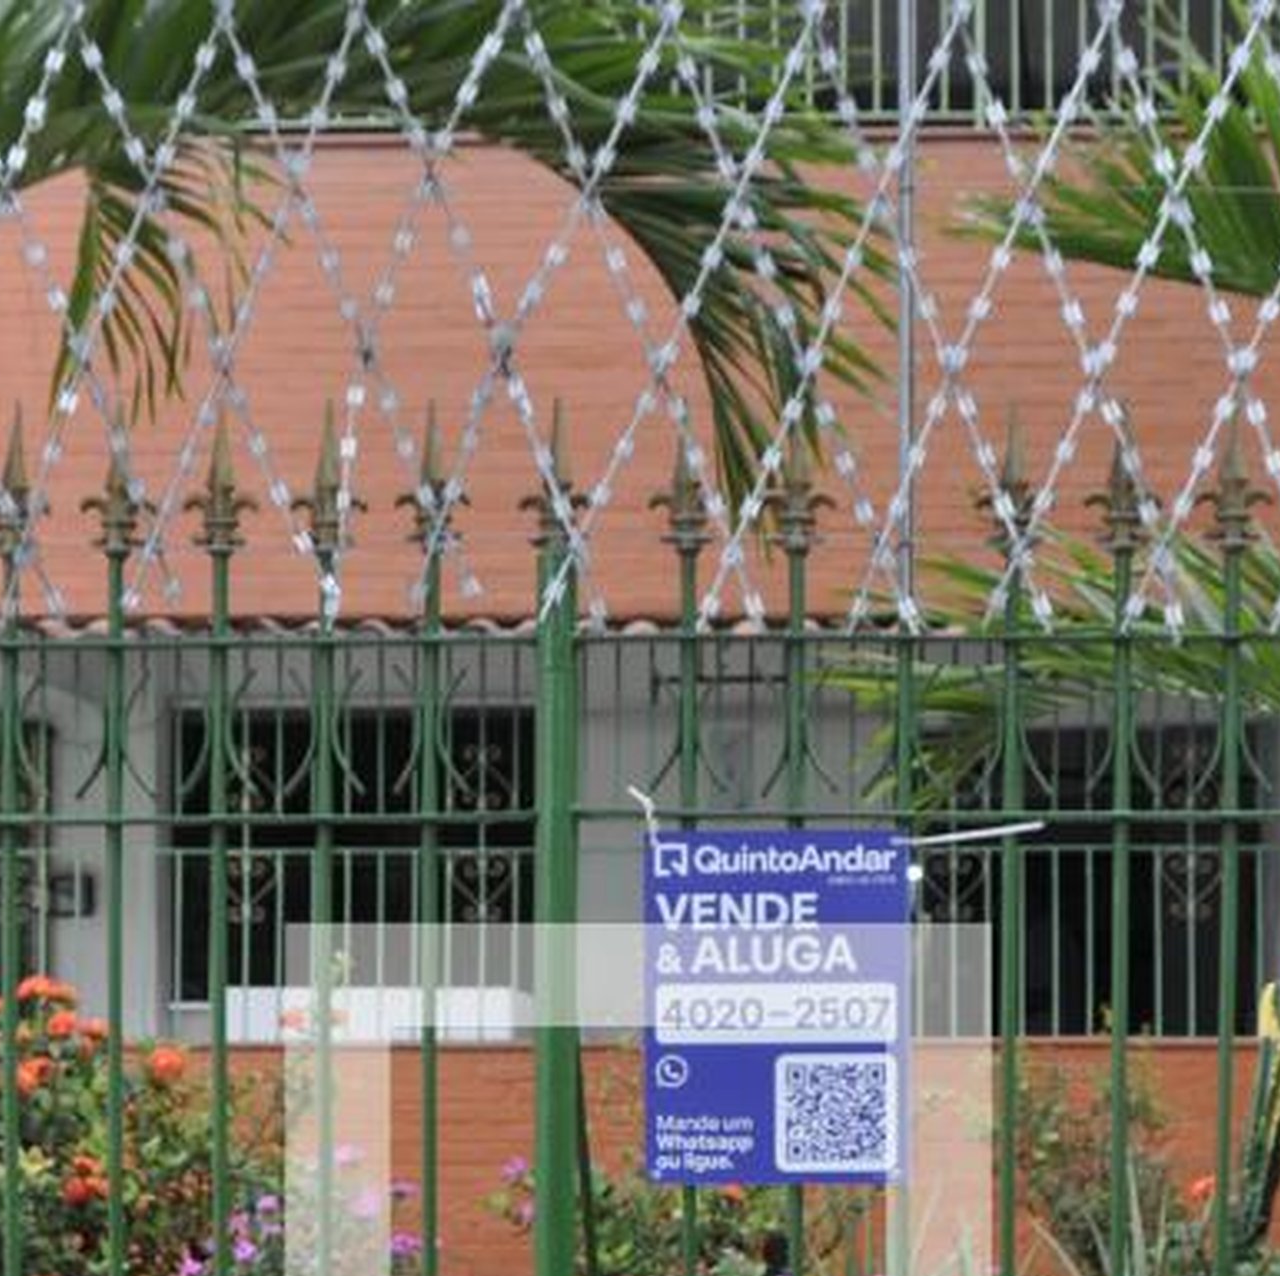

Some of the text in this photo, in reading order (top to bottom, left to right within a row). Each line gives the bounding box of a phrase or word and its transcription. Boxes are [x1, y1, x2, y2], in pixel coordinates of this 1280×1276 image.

[695, 845, 896, 874] QuintoAndar
[655, 892, 819, 930] VENDE
[657, 935, 857, 975] & ALUGA
[662, 997, 891, 1031] 4020-2507
[722, 1116, 754, 1131] um
[655, 1155, 681, 1170] ou
